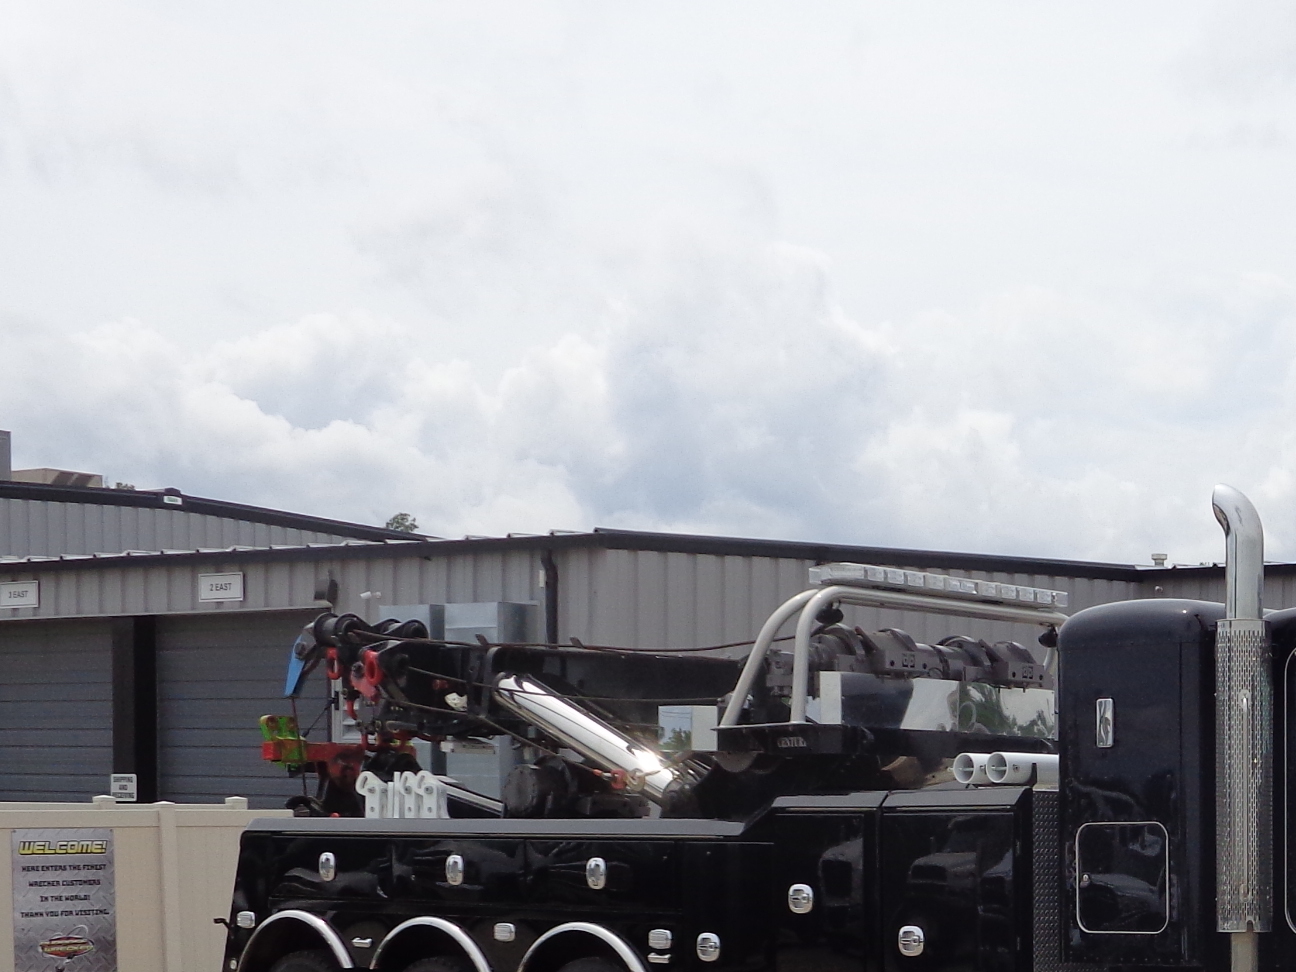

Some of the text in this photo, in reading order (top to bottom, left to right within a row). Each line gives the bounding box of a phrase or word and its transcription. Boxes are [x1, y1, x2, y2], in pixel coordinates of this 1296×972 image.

[209, 582, 232, 592] 2 EAST
[12, 590, 29, 599] EAST
[18, 840, 107, 855] WELCOME!
[21, 865, 40, 873] HERE
[41, 864, 67, 872] ENTERS
[61, 879, 101, 887] CUSTOMERS
[40, 895, 49, 903] IN
[45, 910, 59, 918] YOU
[60, 909, 74, 917] FOR
